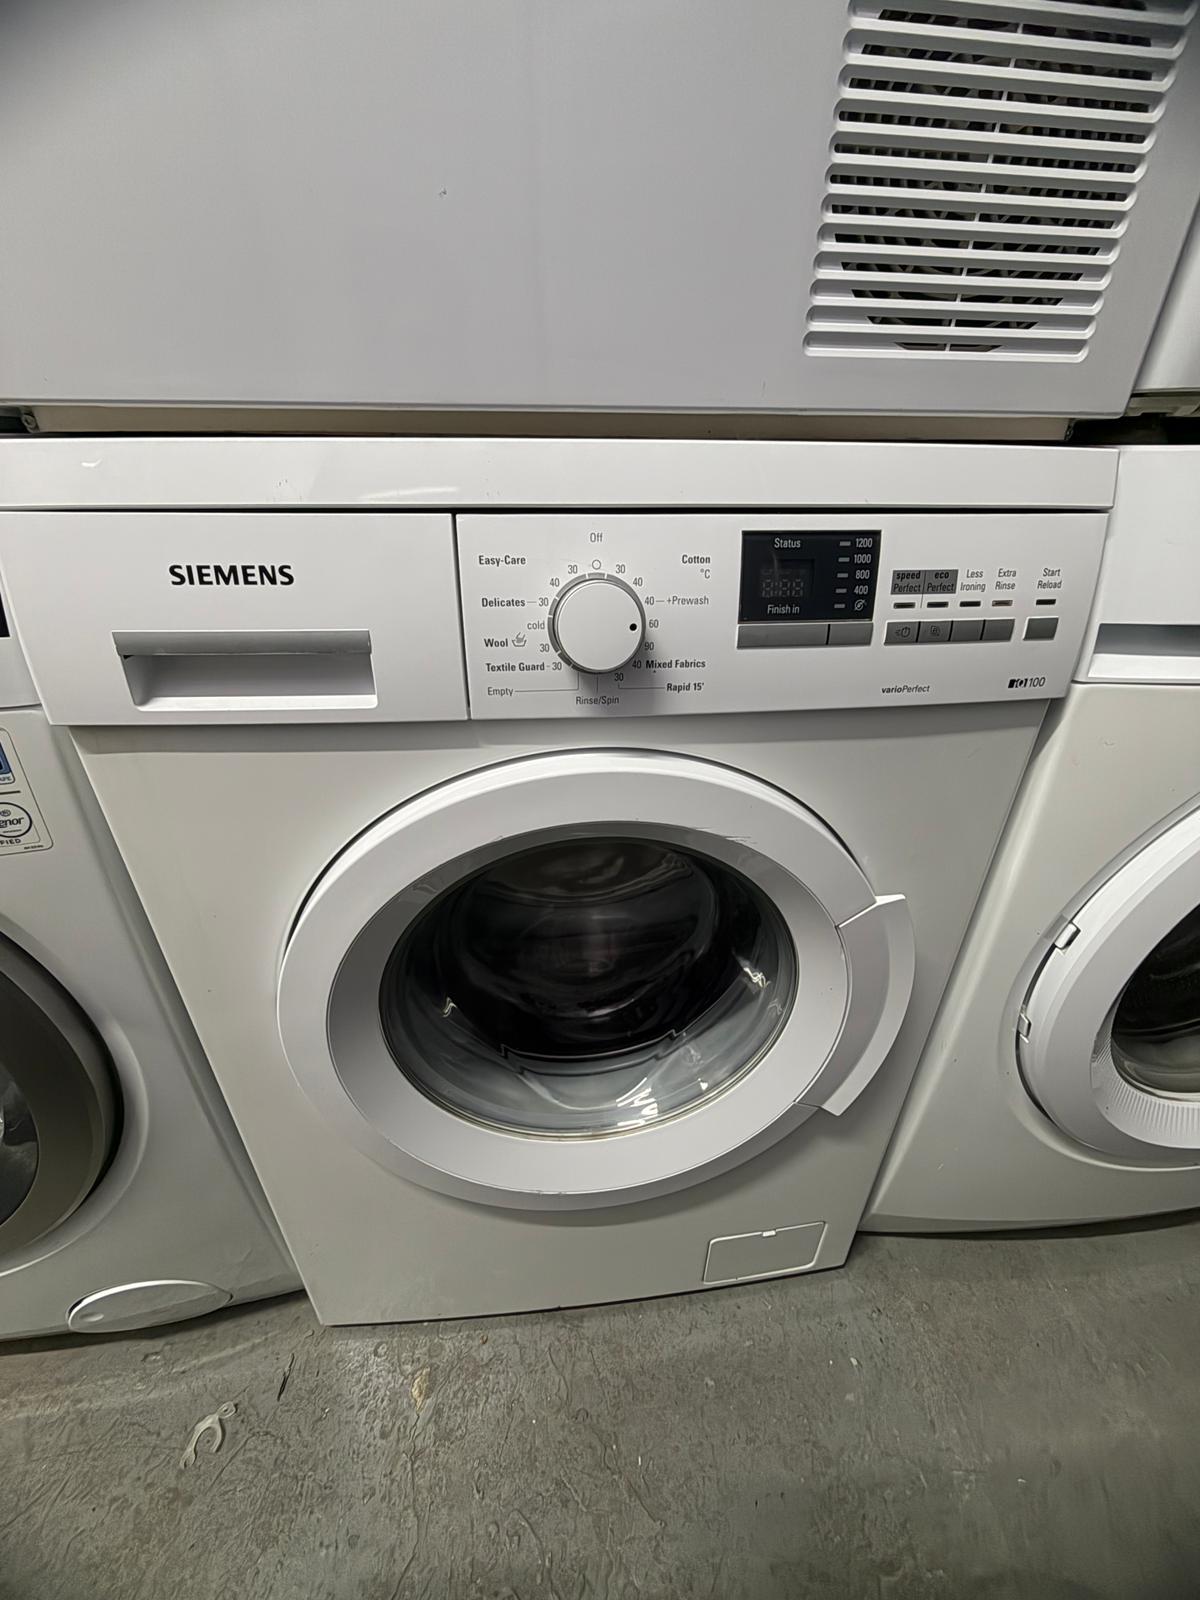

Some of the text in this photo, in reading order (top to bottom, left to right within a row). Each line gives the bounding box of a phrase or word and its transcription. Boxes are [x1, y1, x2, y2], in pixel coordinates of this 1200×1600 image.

[590, 532, 603, 543] Off
[774, 538, 801, 548] Status
[856, 538, 872, 548] 1200
[478, 555, 526, 566] Easy-Care
[681, 555, 711, 564] Cotton
[854, 554, 871, 564] 1000
[567, 565, 578, 575] 30
[615, 564, 626, 574] 30
[966, 569, 983, 578] Less
[998, 569, 1016, 578] Extra
[1043, 568, 1061, 577] Start
[169, 564, 294, 586] SIEMENS
[856, 570, 870, 579] 800
[896, 571, 921, 581] speed
[549, 578, 560, 587] 40
[632, 577, 643, 587] 40
[927, 583, 954, 591] Perfect
[960, 582, 986, 592] Ironing
[995, 582, 1016, 590] Rinse
[1037, 580, 1062, 589] Reload
[854, 586, 868, 595] 400
[893, 584, 921, 592] Perfect
[482, 597, 549, 607] Delicates 30
[644, 595, 709, 606] 40 +Prewash
[767, 604, 800, 614] Finish in
[527, 620, 545, 630] cold
[649, 619, 659, 629] 60
[484, 638, 509, 648] Wool
[540, 643, 550, 653] 30
[644, 641, 655, 651] 90
[486, 661, 562, 672] Textile Guard 30
[632, 659, 706, 669] 40 Mixed Fabrics
[614, 672, 624, 682] 30
[488, 686, 513, 697] Empty
[666, 682, 691, 693] Rapid
[881, 684, 930, 694] varioPerfect
[576, 695, 619, 706] Rinse/Spin
